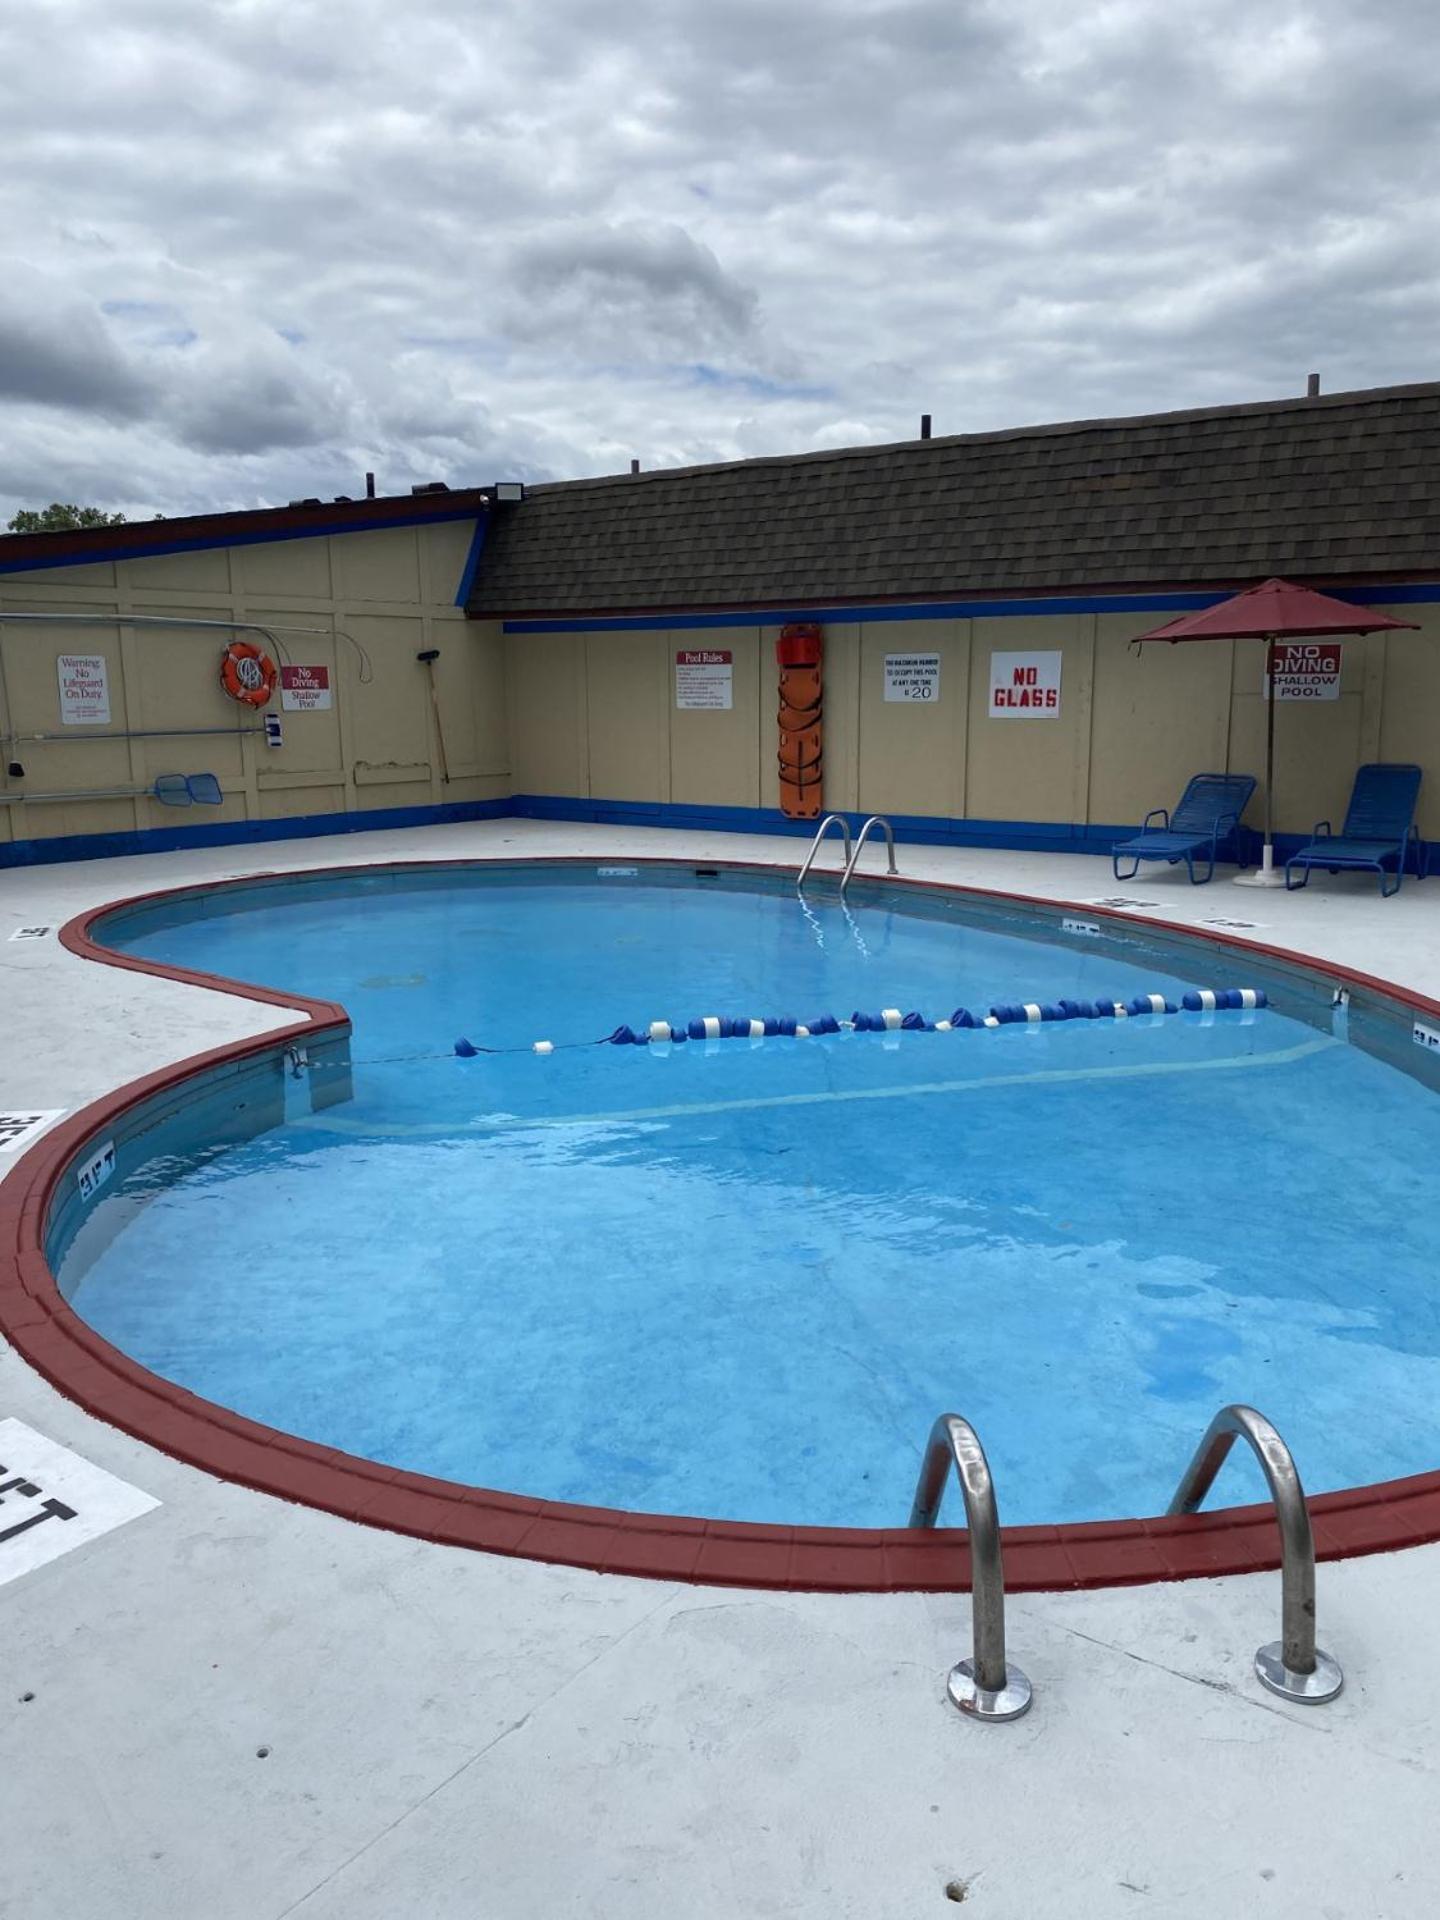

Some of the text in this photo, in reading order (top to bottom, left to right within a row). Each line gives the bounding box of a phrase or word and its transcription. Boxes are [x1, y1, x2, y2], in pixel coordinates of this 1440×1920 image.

[685, 652, 724, 664] Pool Rules
[1287, 646, 1320, 659] NO
[1274, 658, 1336, 673] DIVING
[75, 668, 90, 678] No
[297, 667, 312, 679] No
[1013, 667, 1038, 686] NO
[63, 678, 103, 690] Lifeguard
[291, 677, 320, 689] Diving
[66, 688, 80, 699] On
[291, 690, 320, 701] Shallow
[911, 686, 931, 699] 20
[994, 688, 1057, 707] GLASS
[1280, 687, 1322, 697] POOL
[298, 699, 316, 709] Pool
